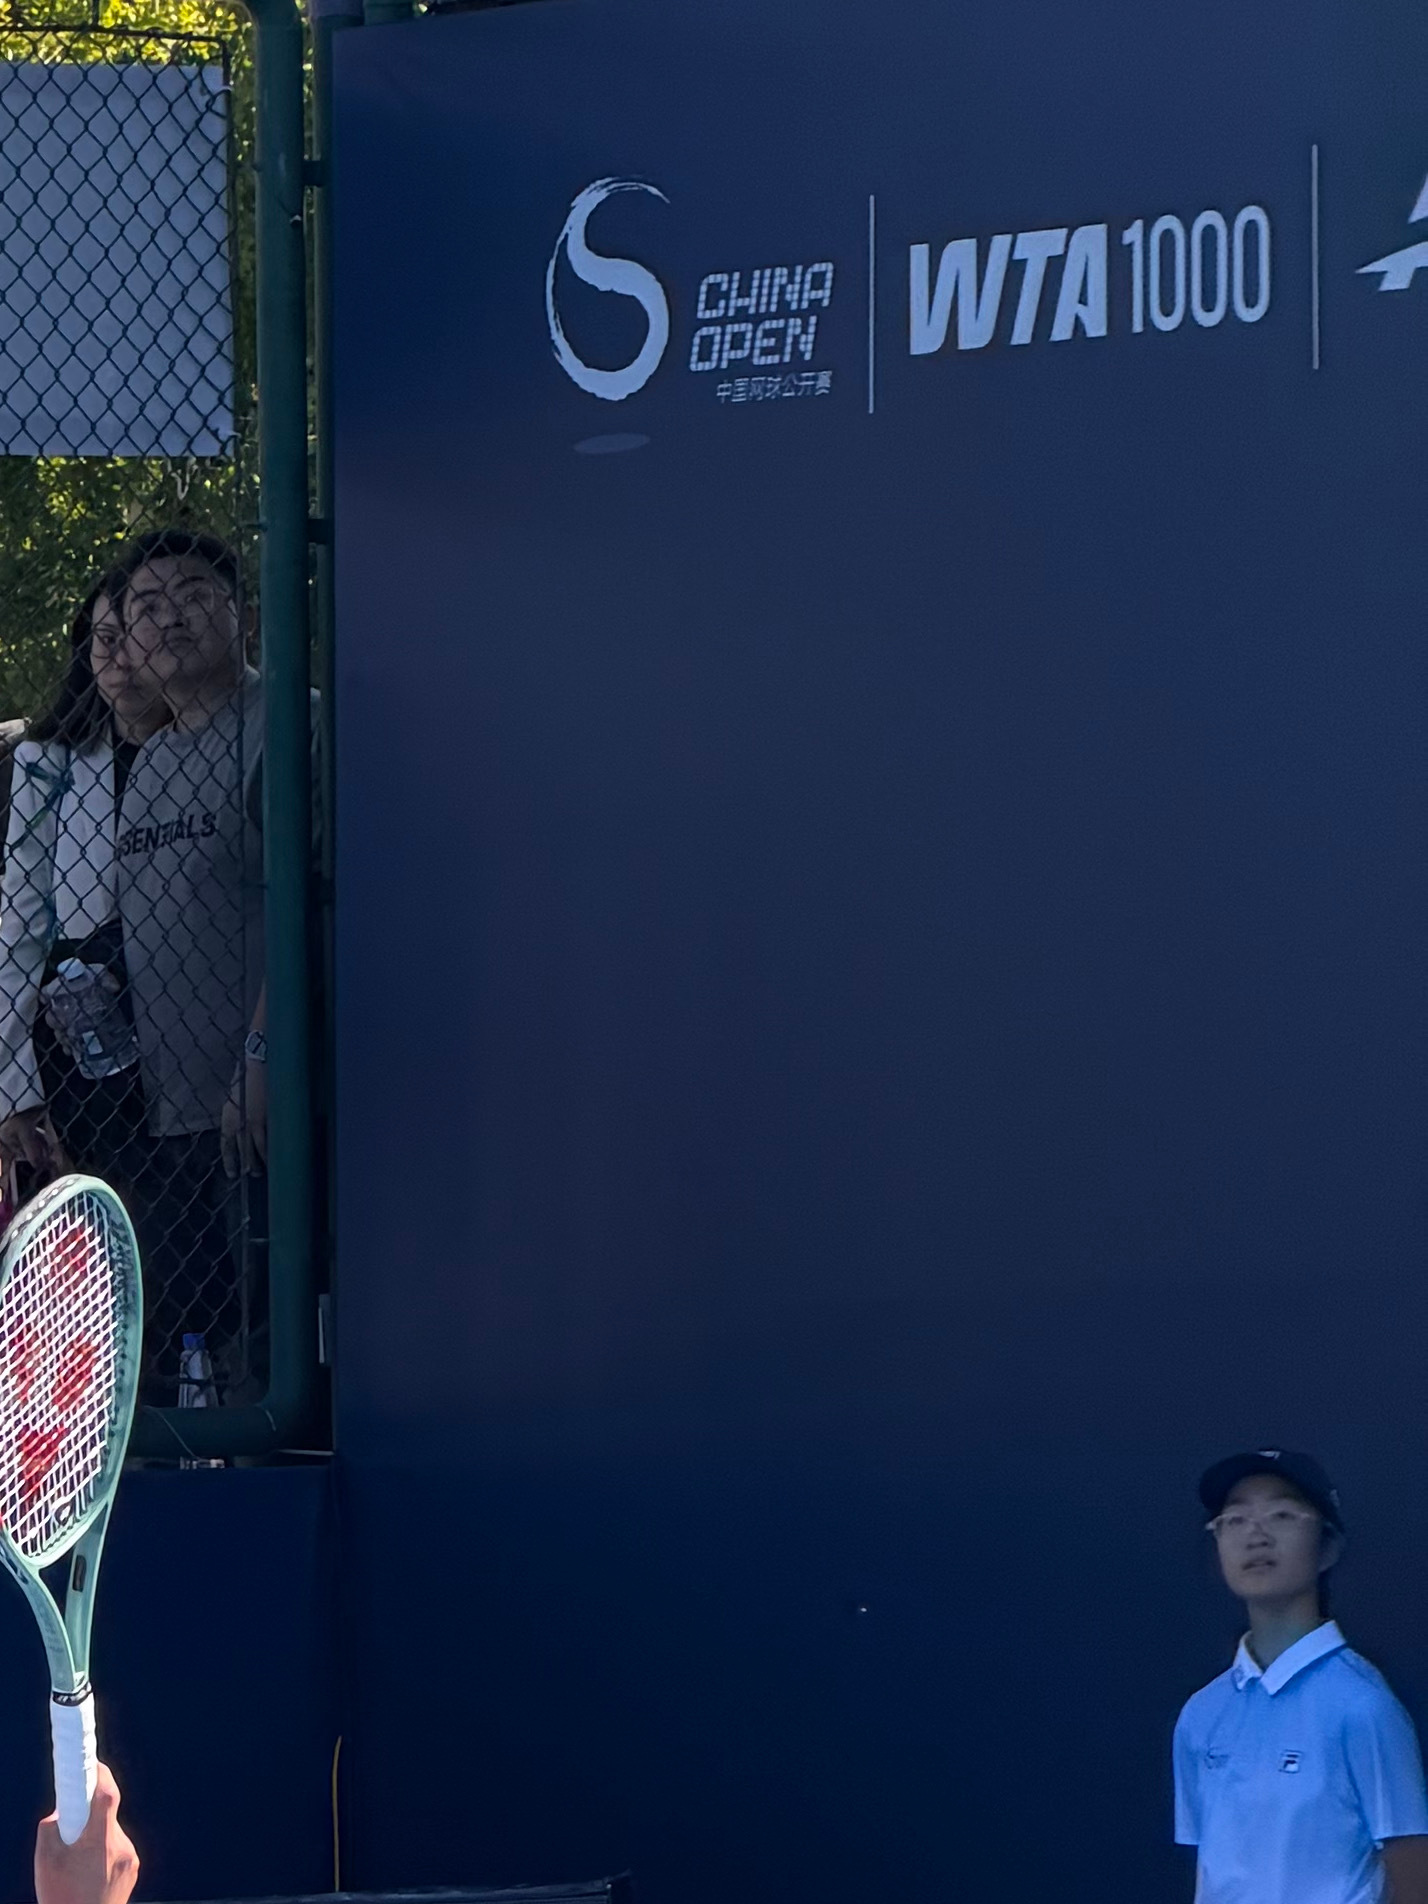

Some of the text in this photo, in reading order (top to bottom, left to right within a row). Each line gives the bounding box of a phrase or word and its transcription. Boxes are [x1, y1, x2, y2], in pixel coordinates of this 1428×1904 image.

[696, 261, 835, 320] CHINA
[689, 314, 818, 373] OPEN
[119, 812, 217, 856] SENTIALS
